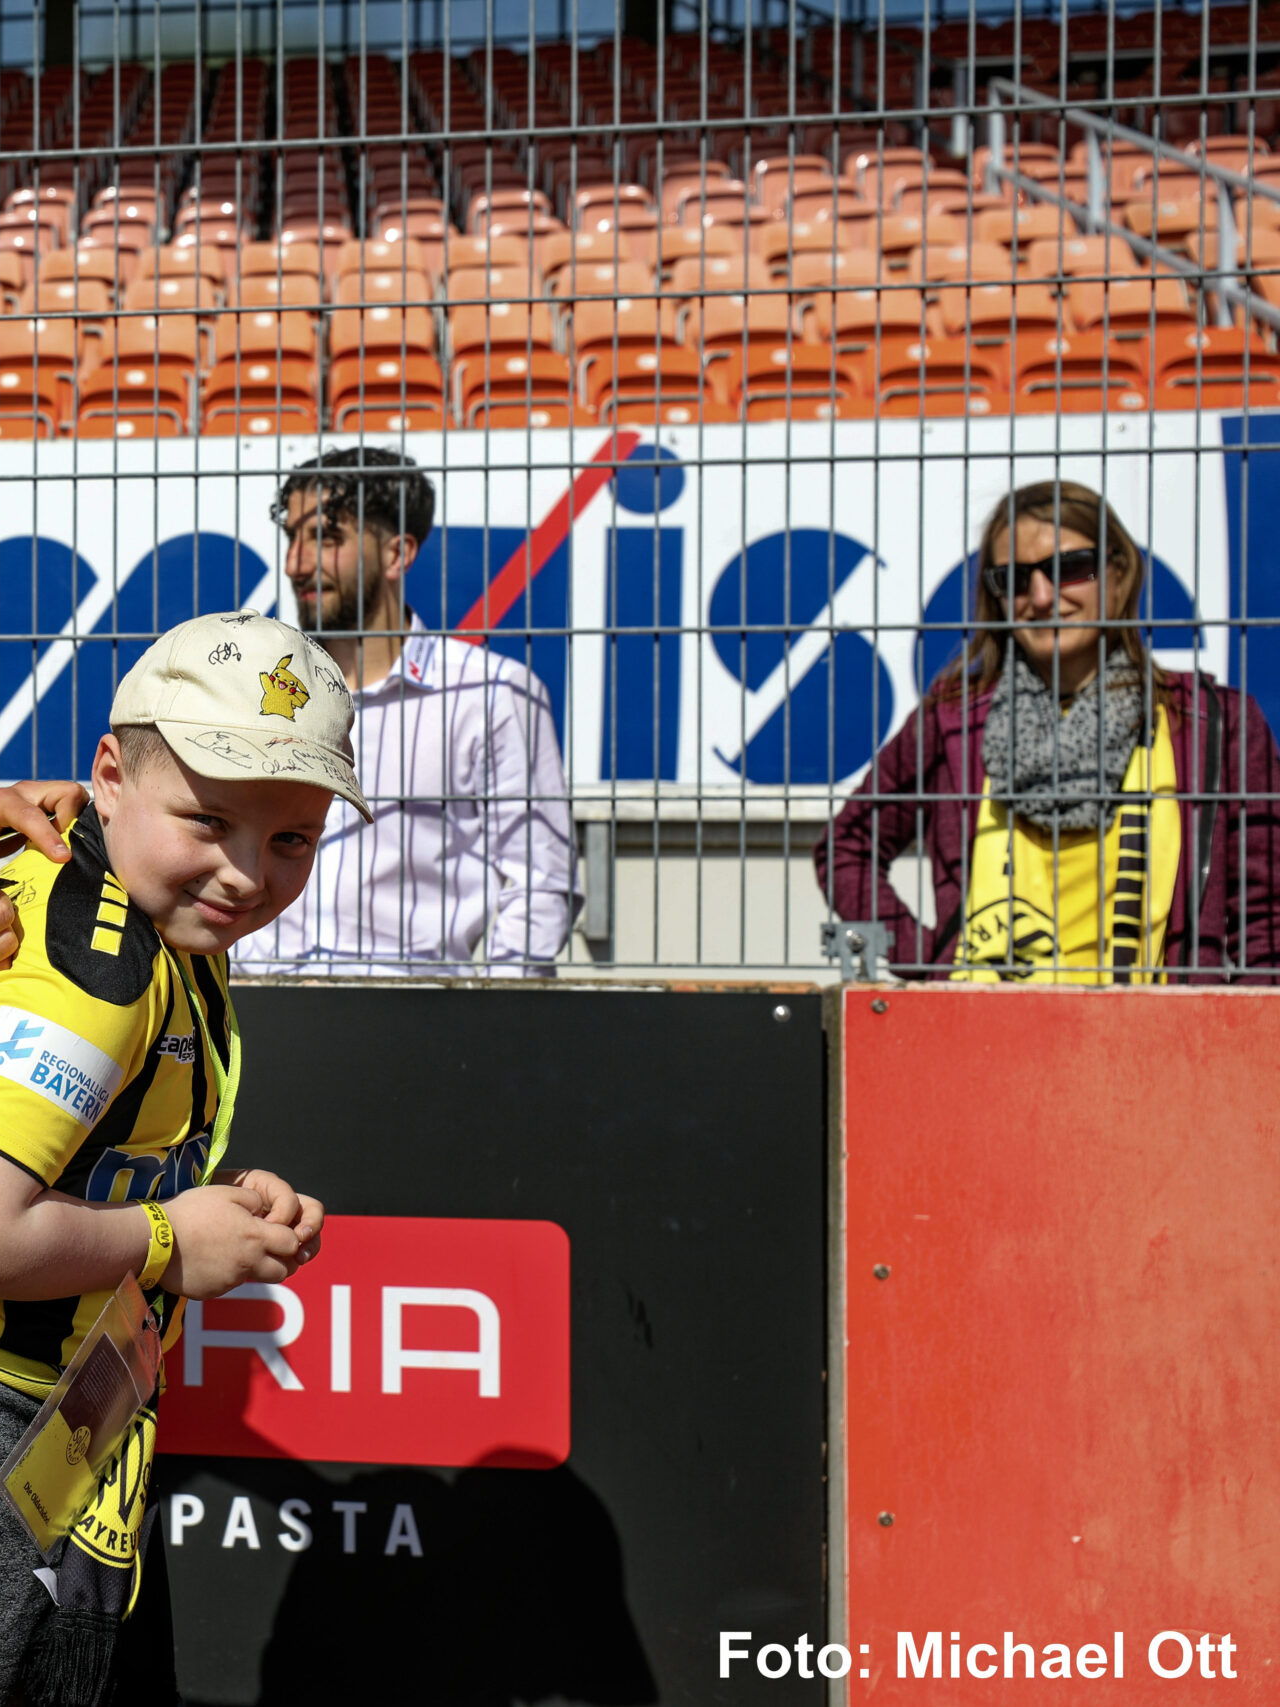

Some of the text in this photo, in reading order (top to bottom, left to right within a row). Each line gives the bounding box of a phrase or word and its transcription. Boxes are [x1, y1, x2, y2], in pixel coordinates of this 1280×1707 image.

[30, 1062, 104, 1123] BAYERN
[40, 1050, 110, 1103] REGIONALLIGA
[171, 1493, 424, 1557] PASTA
